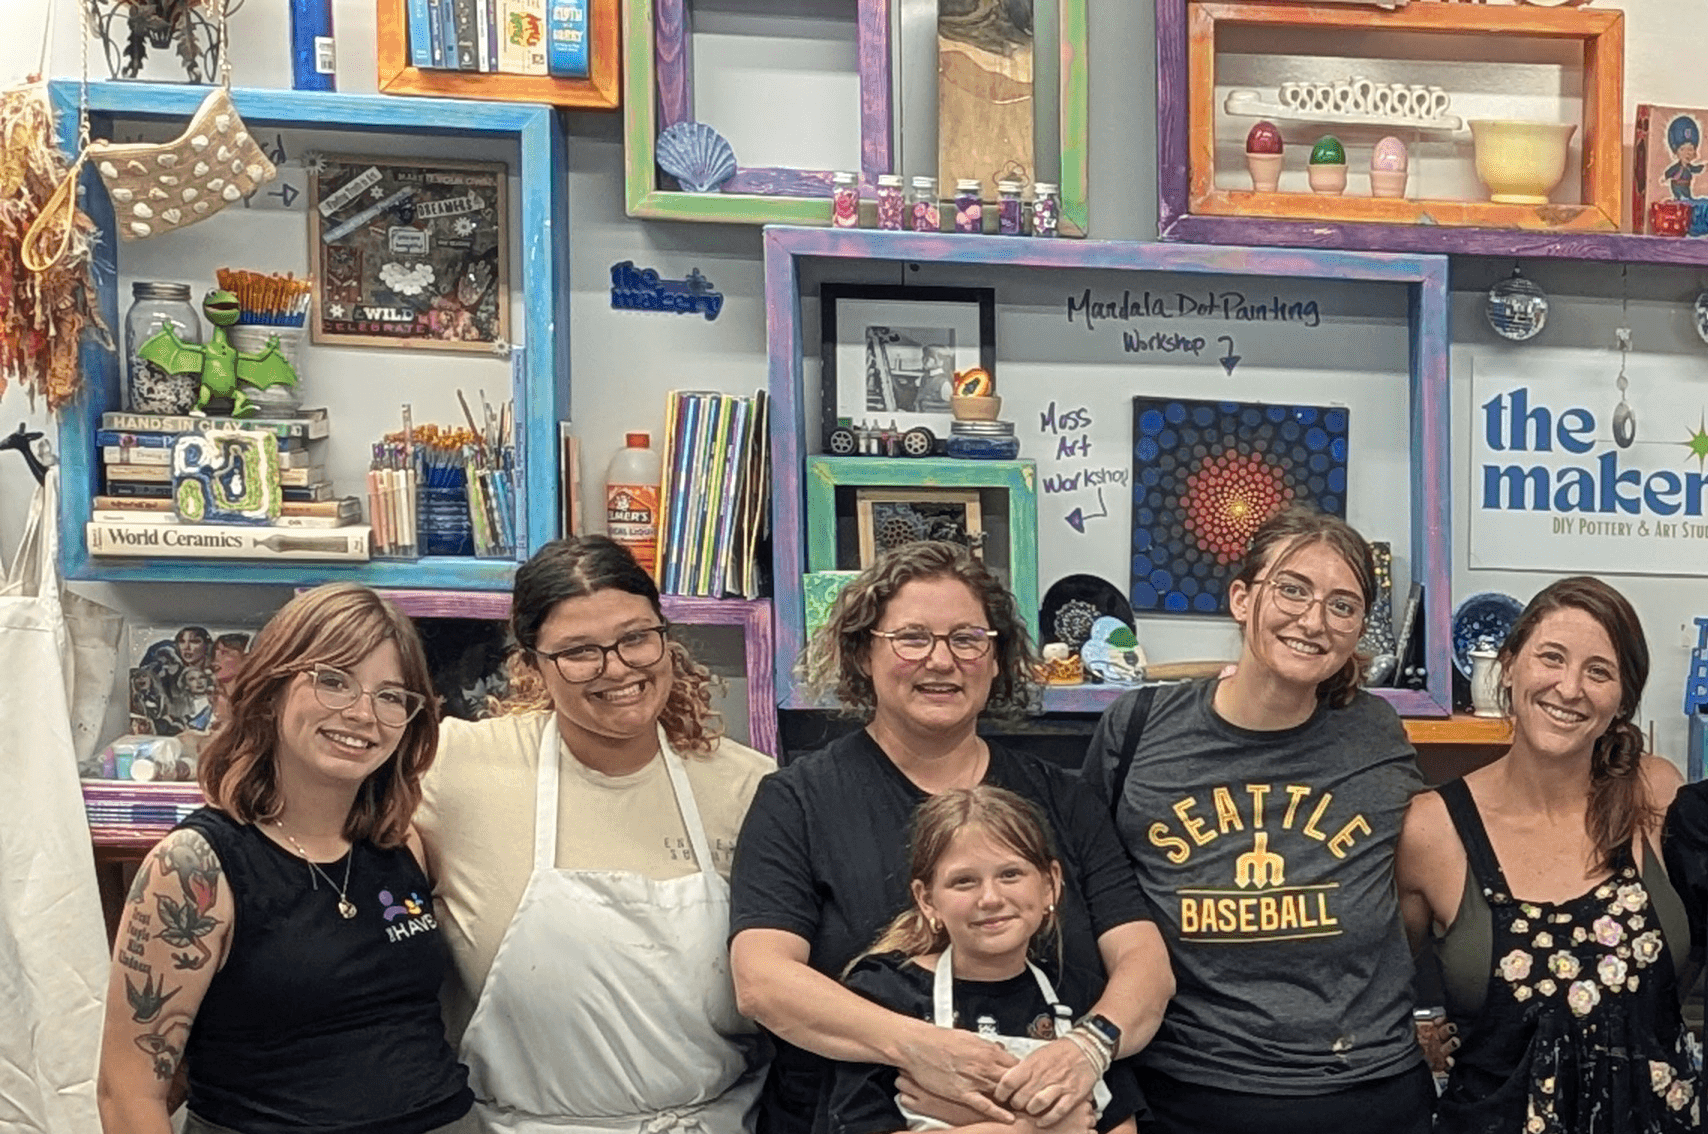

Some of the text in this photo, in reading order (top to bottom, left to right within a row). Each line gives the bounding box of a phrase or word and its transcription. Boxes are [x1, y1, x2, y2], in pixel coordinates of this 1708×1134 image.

[1067, 288, 1173, 330] Mandala
[1219, 292, 1320, 327] Painting
[1123, 328, 1206, 357] Workshop
[114, 416, 173, 431] HANDS
[178, 419, 194, 431] IN
[1040, 401, 1092, 435] Moss
[1481, 387, 1596, 454] the
[1056, 435, 1092, 460] Art
[108, 528, 158, 546] World
[163, 529, 243, 548] Ceramics
[1552, 516, 1575, 535] DIY
[1637, 520, 1650, 537] &
[1148, 784, 1372, 864] SEATTLE
[1181, 893, 1338, 932] BASEBALL
